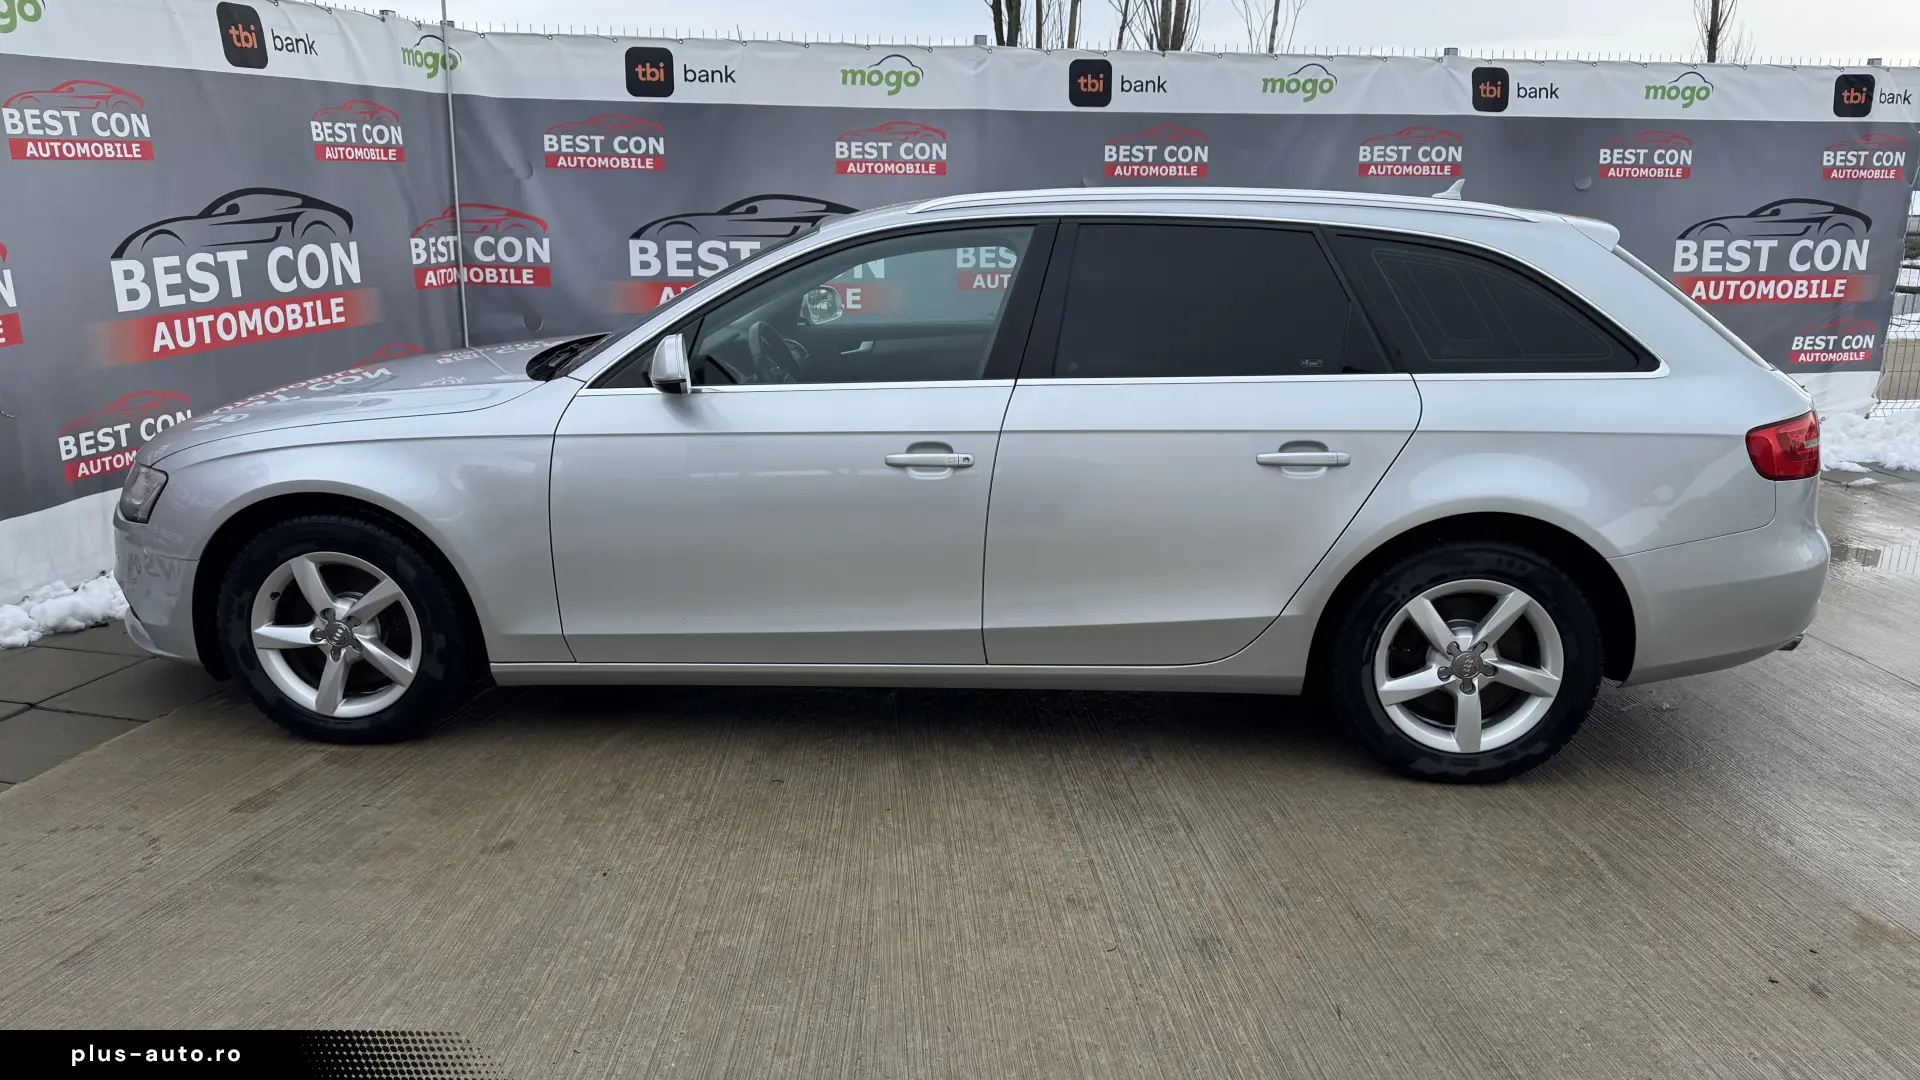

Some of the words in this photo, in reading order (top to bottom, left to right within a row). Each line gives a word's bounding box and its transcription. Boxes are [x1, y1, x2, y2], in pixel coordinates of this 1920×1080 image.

[0, 0, 42, 33] go
[228, 24, 258, 50] tbi
[271, 29, 318, 57] bank
[401, 46, 459, 79] mogo
[635, 62, 665, 82] tbi
[683, 64, 737, 84] bank
[840, 66, 921, 96] mogo
[1077, 73, 1103, 93] tbi
[1120, 75, 1167, 94] bank
[1261, 76, 1334, 103] mogo
[1479, 80, 1502, 99] tbi
[1517, 83, 1559, 99] bank
[1645, 84, 1710, 109] mogo
[1842, 87, 1867, 104] tbi
[1879, 88, 1912, 105] bank
[2, 107, 80, 137] BEST
[91, 111, 150, 138] CON
[310, 120, 357, 144] BEST
[362, 124, 403, 146] CON
[25, 140, 142, 158] AUTOMOBILE
[324, 145, 397, 161] AUTOMOBILE
[543, 134, 605, 154] BEST
[613, 135, 665, 155] CON
[834, 141, 892, 160] BEST
[900, 142, 947, 160] CON
[1104, 145, 1157, 163] BEST
[1164, 145, 1209, 163] CON
[1358, 145, 1411, 162] BEST
[1418, 145, 1462, 162] CON
[557, 155, 654, 169] AUTOMOBILE
[846, 160, 936, 174] AUTOMOBILE
[1599, 148, 1648, 165] BEST
[1654, 149, 1692, 165] CON
[1822, 151, 1868, 166] BEST
[1872, 151, 1905, 167] CON
[1114, 165, 1198, 177] AUTOMOBILE
[1368, 165, 1451, 176] AUTOMOBILE
[1607, 168, 1682, 178] AUTOMOBILE
[1830, 168, 1896, 179] AUTOMOBILE
[474, 236, 550, 263] CON
[957, 246, 1017, 268] BES
[1673, 239, 1779, 273] BEST
[1789, 239, 1870, 272] CON
[110, 249, 249, 313] BEST
[267, 241, 362, 293] CON
[1691, 279, 1847, 300] AUTOMOBILE
[152, 297, 346, 353] AUTOMOBILE
[1792, 336, 1838, 351] BEST
[1841, 335, 1875, 349] CON
[1798, 351, 1866, 362] AUTOMOBILE
[58, 423, 131, 461] BEST
